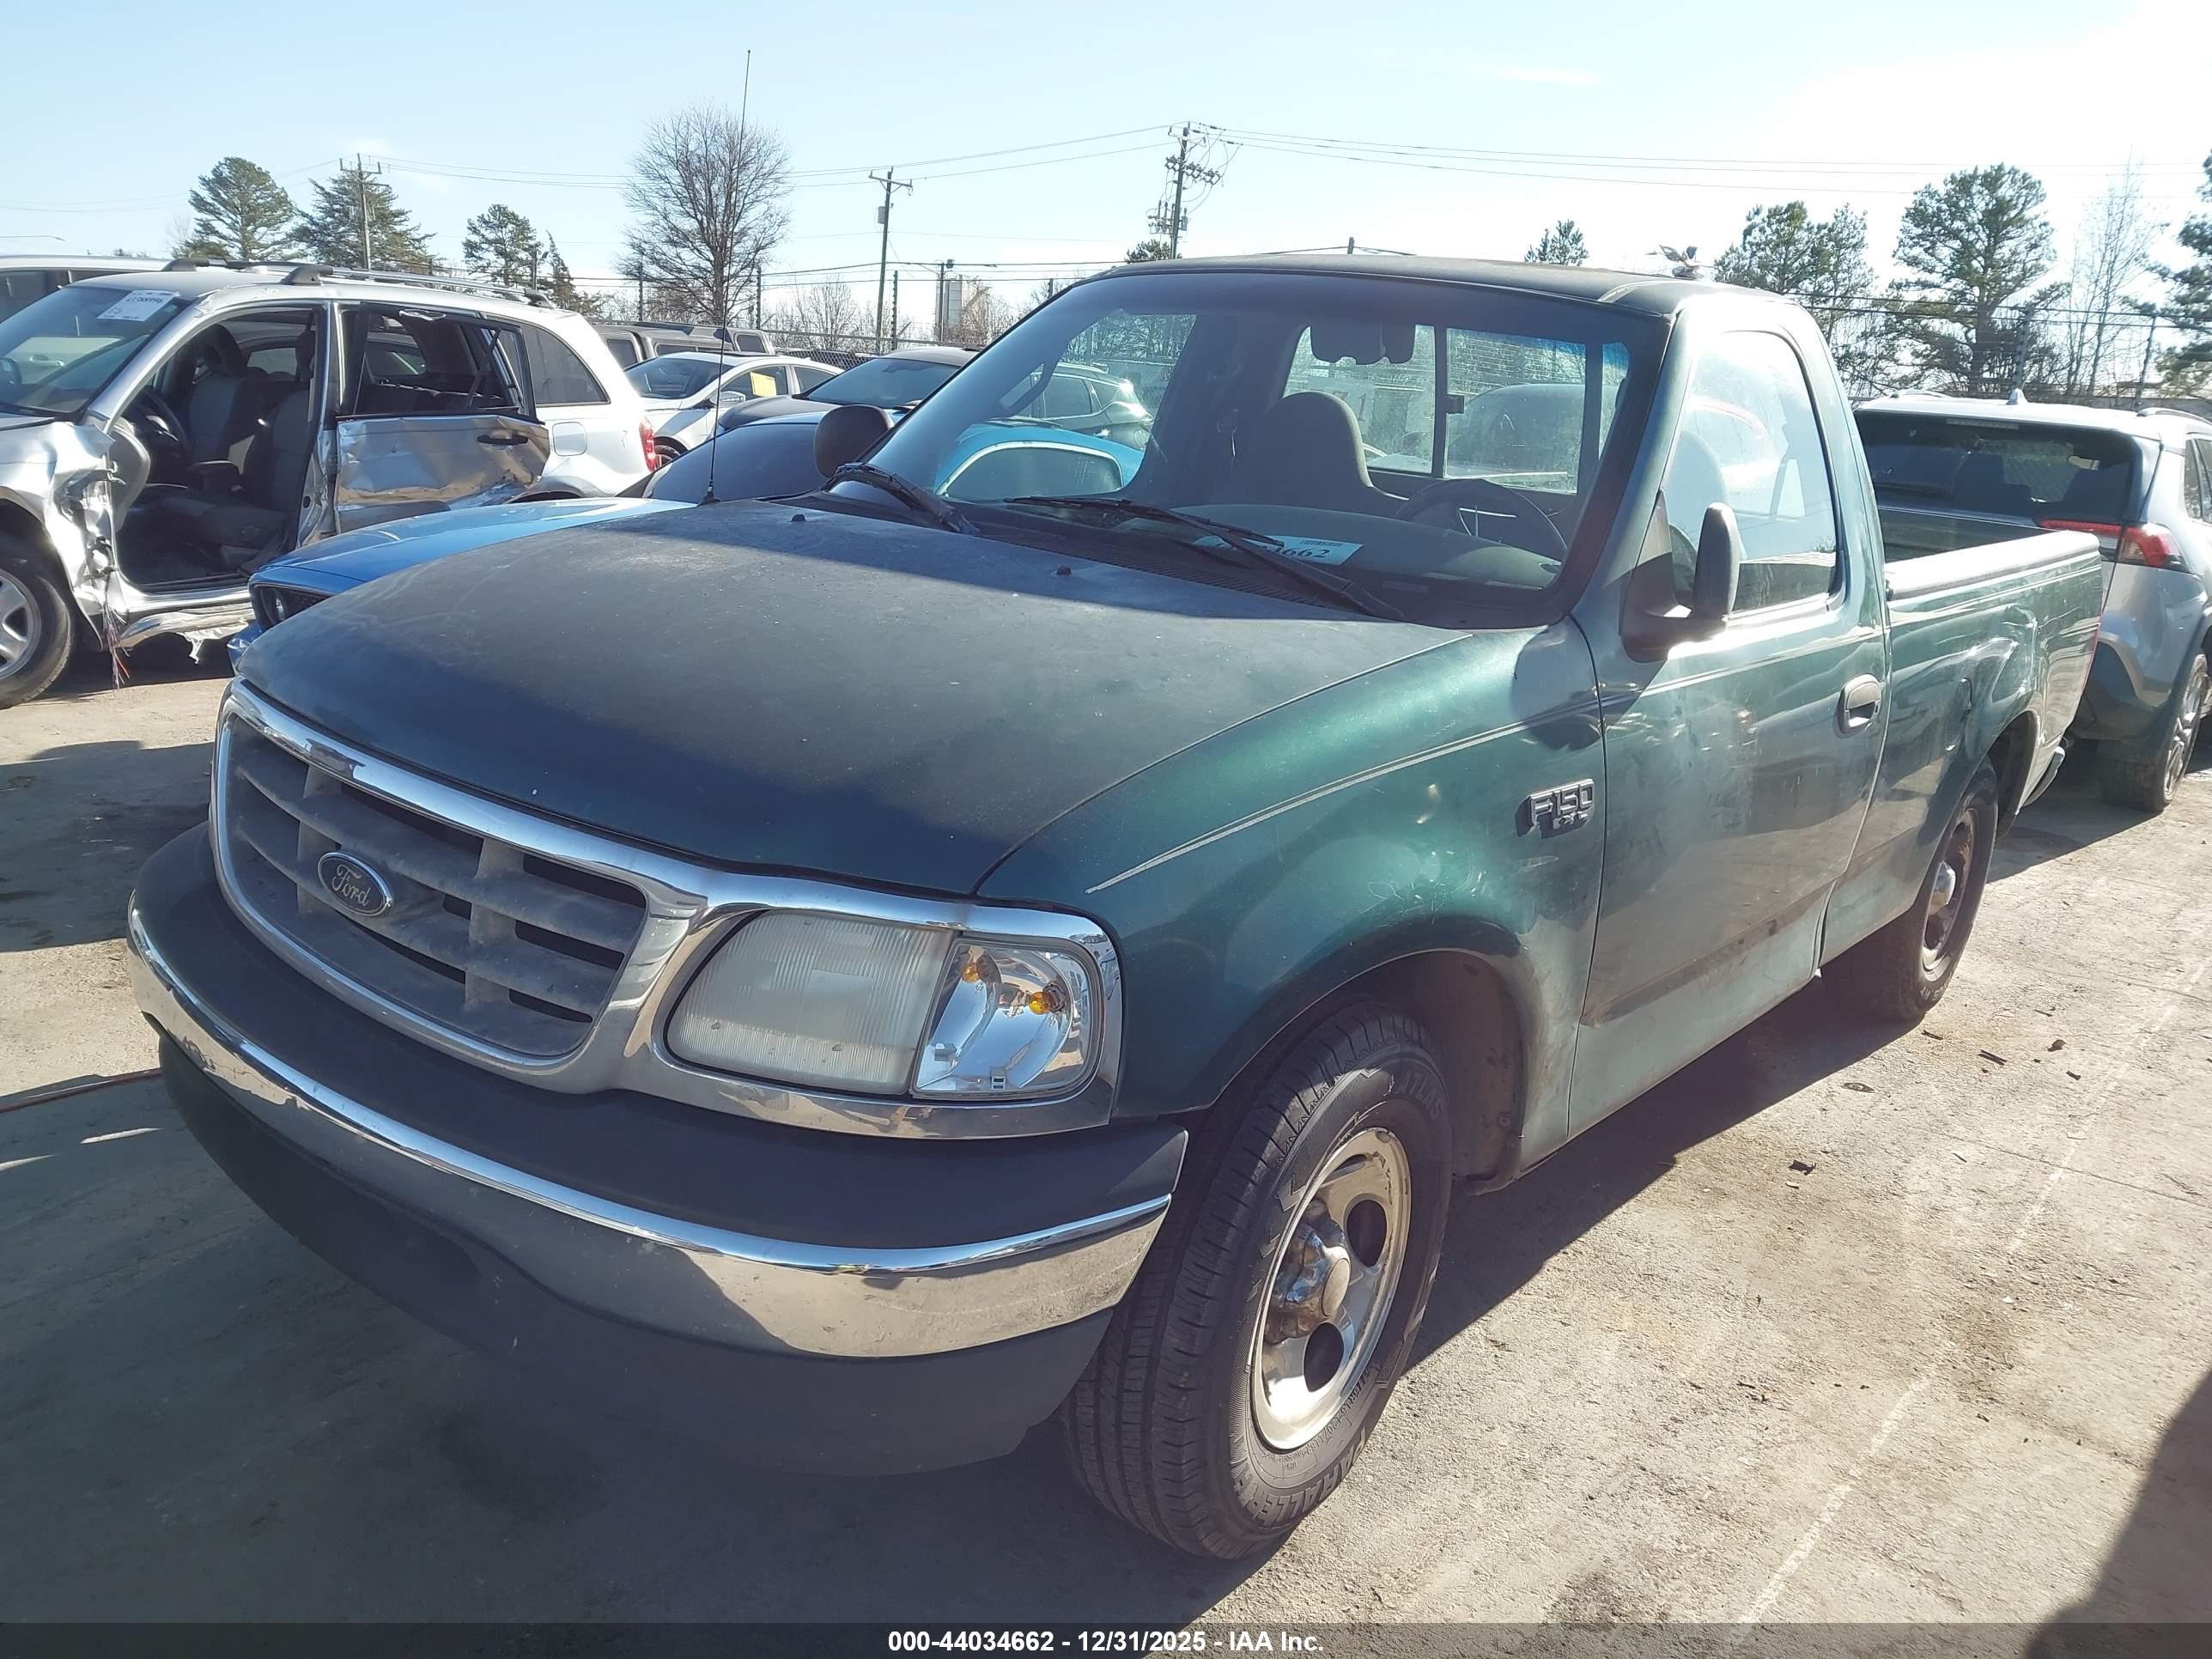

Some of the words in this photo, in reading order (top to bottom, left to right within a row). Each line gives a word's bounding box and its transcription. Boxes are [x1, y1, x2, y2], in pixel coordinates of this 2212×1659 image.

[1530, 779, 1595, 825] F150
[331, 864, 371, 906] Ford
[1394, 1071, 1443, 1121] ATLAS
